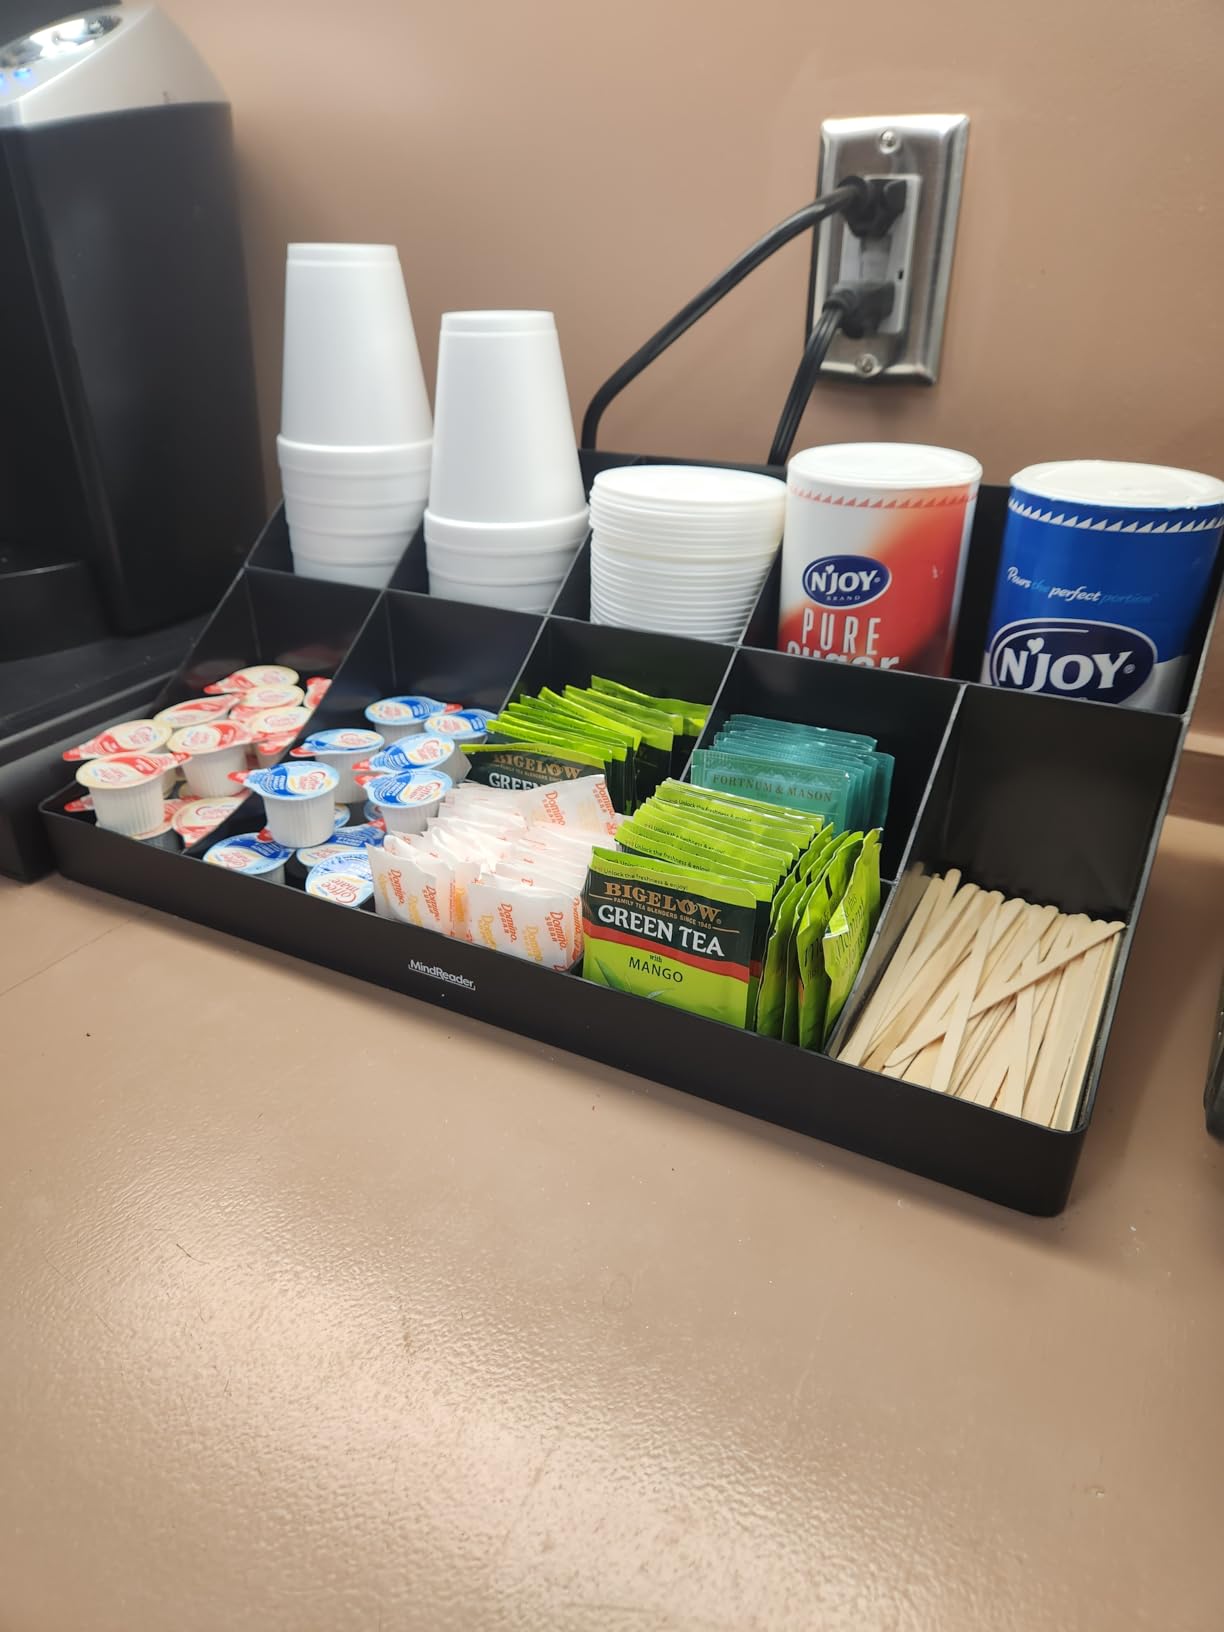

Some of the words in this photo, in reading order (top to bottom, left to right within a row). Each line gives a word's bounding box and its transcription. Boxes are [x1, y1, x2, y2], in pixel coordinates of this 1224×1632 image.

[1007, 566, 1032, 589] Pours
[1048, 585, 1102, 602] perfect
[802, 607, 881, 656] PURE
[493, 754, 583, 779] BIGELOW
[713, 774, 772, 793] FORTNUM
[775, 786, 784, 794] &
[787, 787, 833, 802] MASON
[545, 790, 566, 826] Domino
[604, 882, 722, 922] BIGELOW
[613, 897, 634, 906] FAMILY
[635, 902, 645, 910] TEA
[680, 914, 697, 925] SINCE
[500, 903, 517, 942] Domino
[549, 911, 567, 950] Domino
[598, 905, 673, 942] GREEN
[679, 926, 725, 957] TEA
[409, 959, 475, 989] MindReader
[629, 957, 683, 983] MANGO
[650, 954, 662, 963] with
